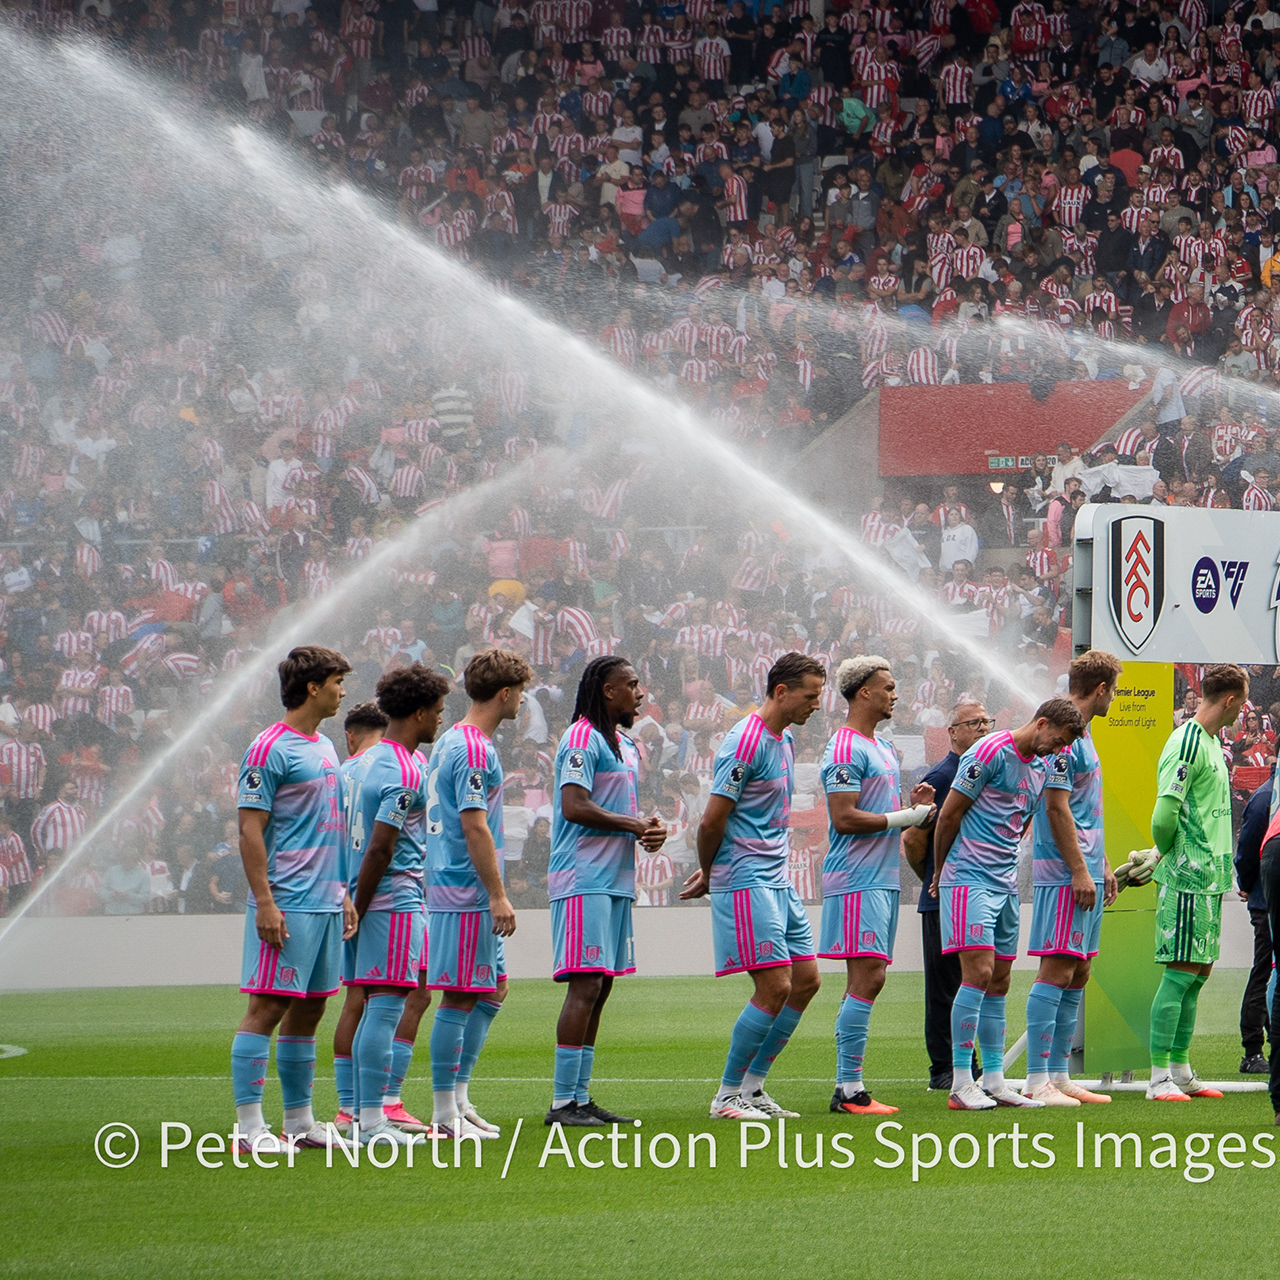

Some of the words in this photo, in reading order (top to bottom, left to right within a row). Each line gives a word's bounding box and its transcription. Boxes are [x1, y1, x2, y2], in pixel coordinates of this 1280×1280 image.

[1125, 529, 1152, 623] FFC
[1196, 569, 1216, 589] EA
[1195, 588, 1217, 599] SPORTS
[1134, 687, 1156, 699] League
[1119, 702, 1131, 712] Live
[1132, 701, 1146, 712] from
[1109, 717, 1133, 727] Stadium
[1134, 717, 1141, 727] of
[1142, 718, 1156, 729] Light
